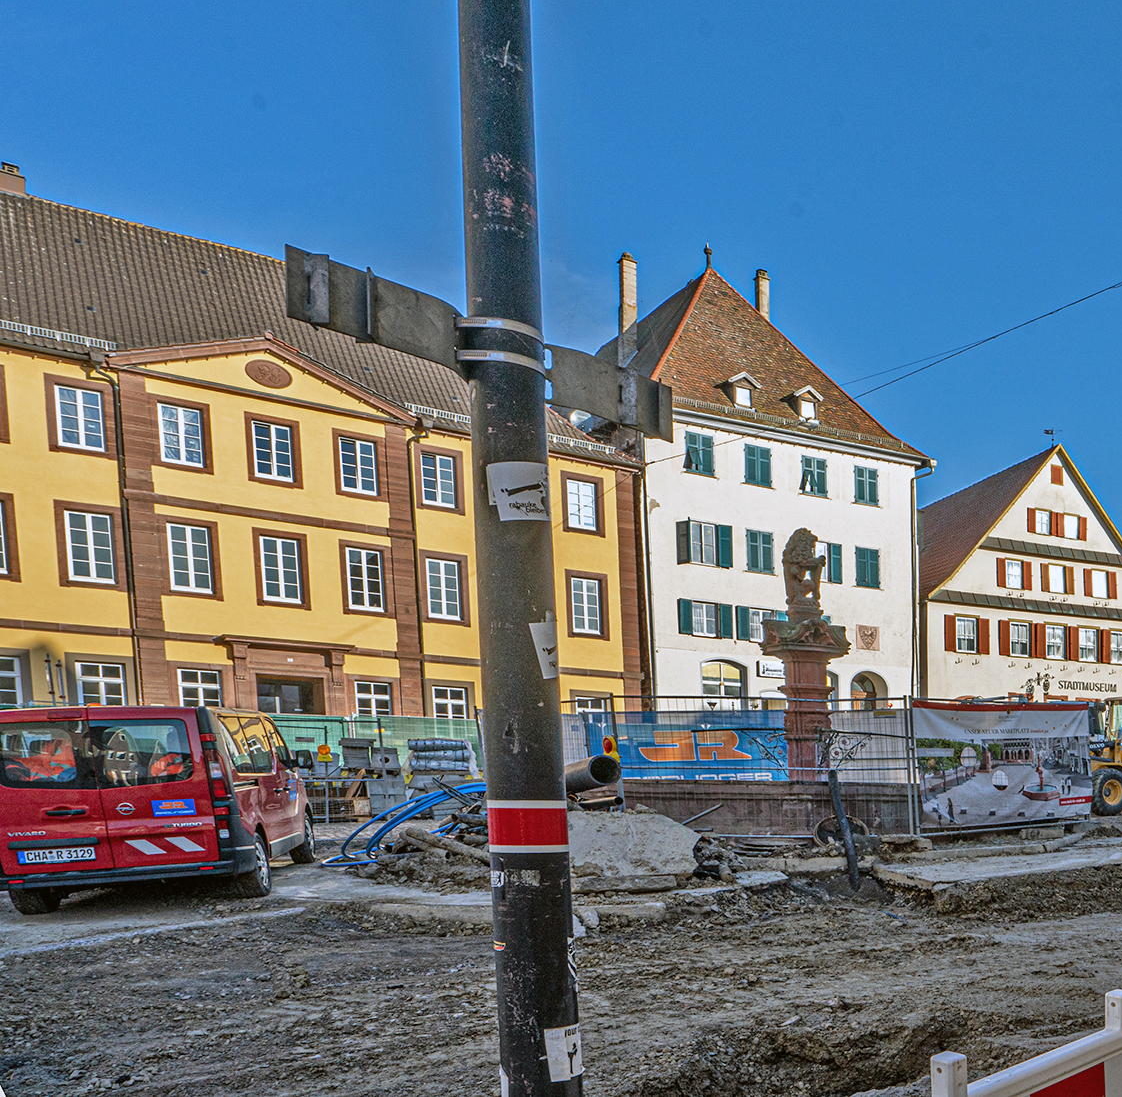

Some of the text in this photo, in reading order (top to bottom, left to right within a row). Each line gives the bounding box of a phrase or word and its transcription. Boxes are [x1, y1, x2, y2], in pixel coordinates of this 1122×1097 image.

[1058, 680, 1117, 693] STADTMUSEUM
[26, 848, 93, 861] CHA R 3129
